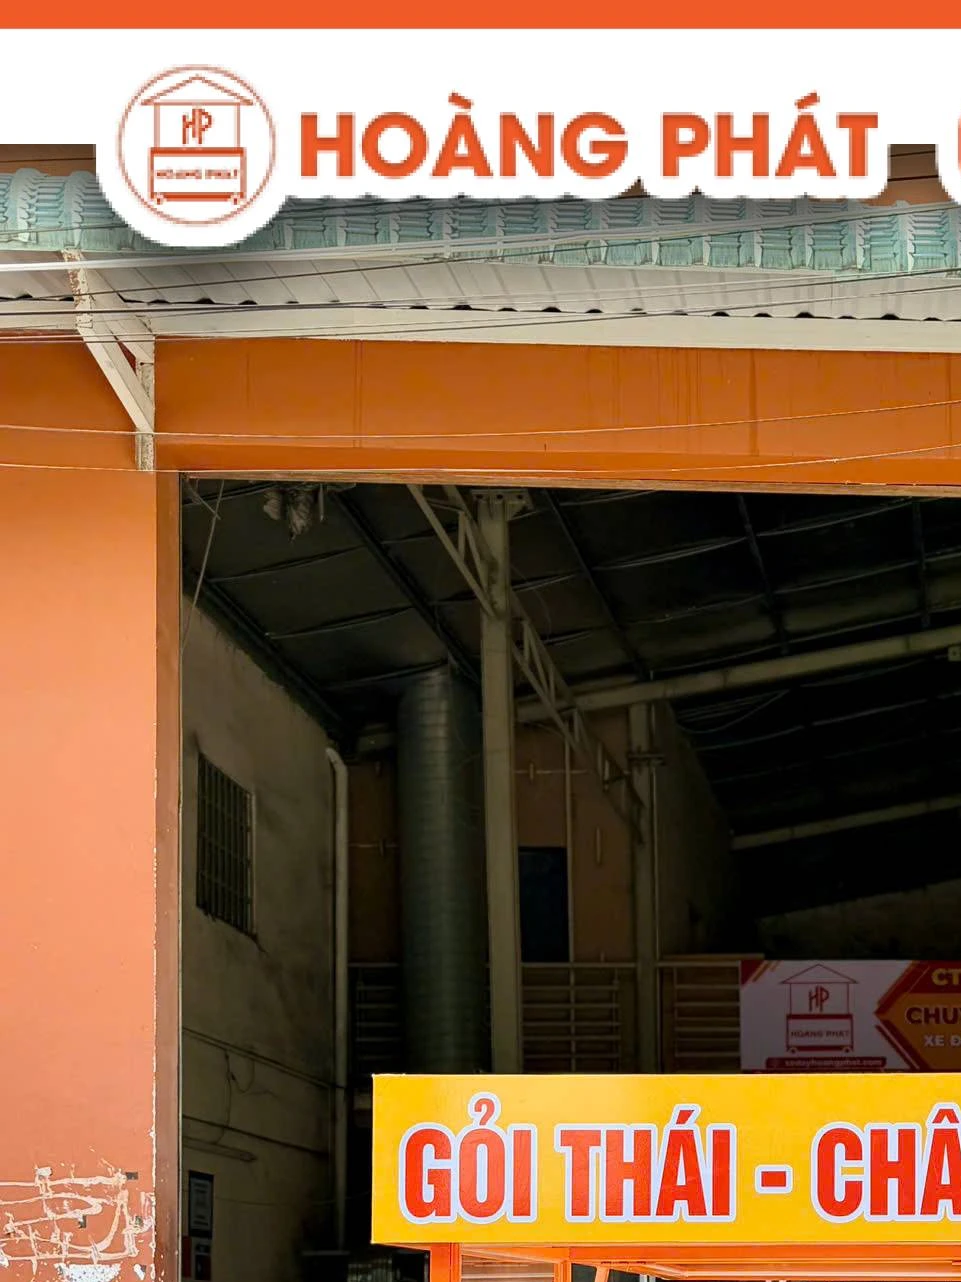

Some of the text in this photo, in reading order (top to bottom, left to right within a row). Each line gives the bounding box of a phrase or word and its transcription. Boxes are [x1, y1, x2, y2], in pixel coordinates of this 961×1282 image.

[924, 1034, 945, 1047] XE
[403, 1099, 533, 1219] GỎI
[559, 1108, 733, 1218] THÁI
[760, 1170, 788, 1188] -
